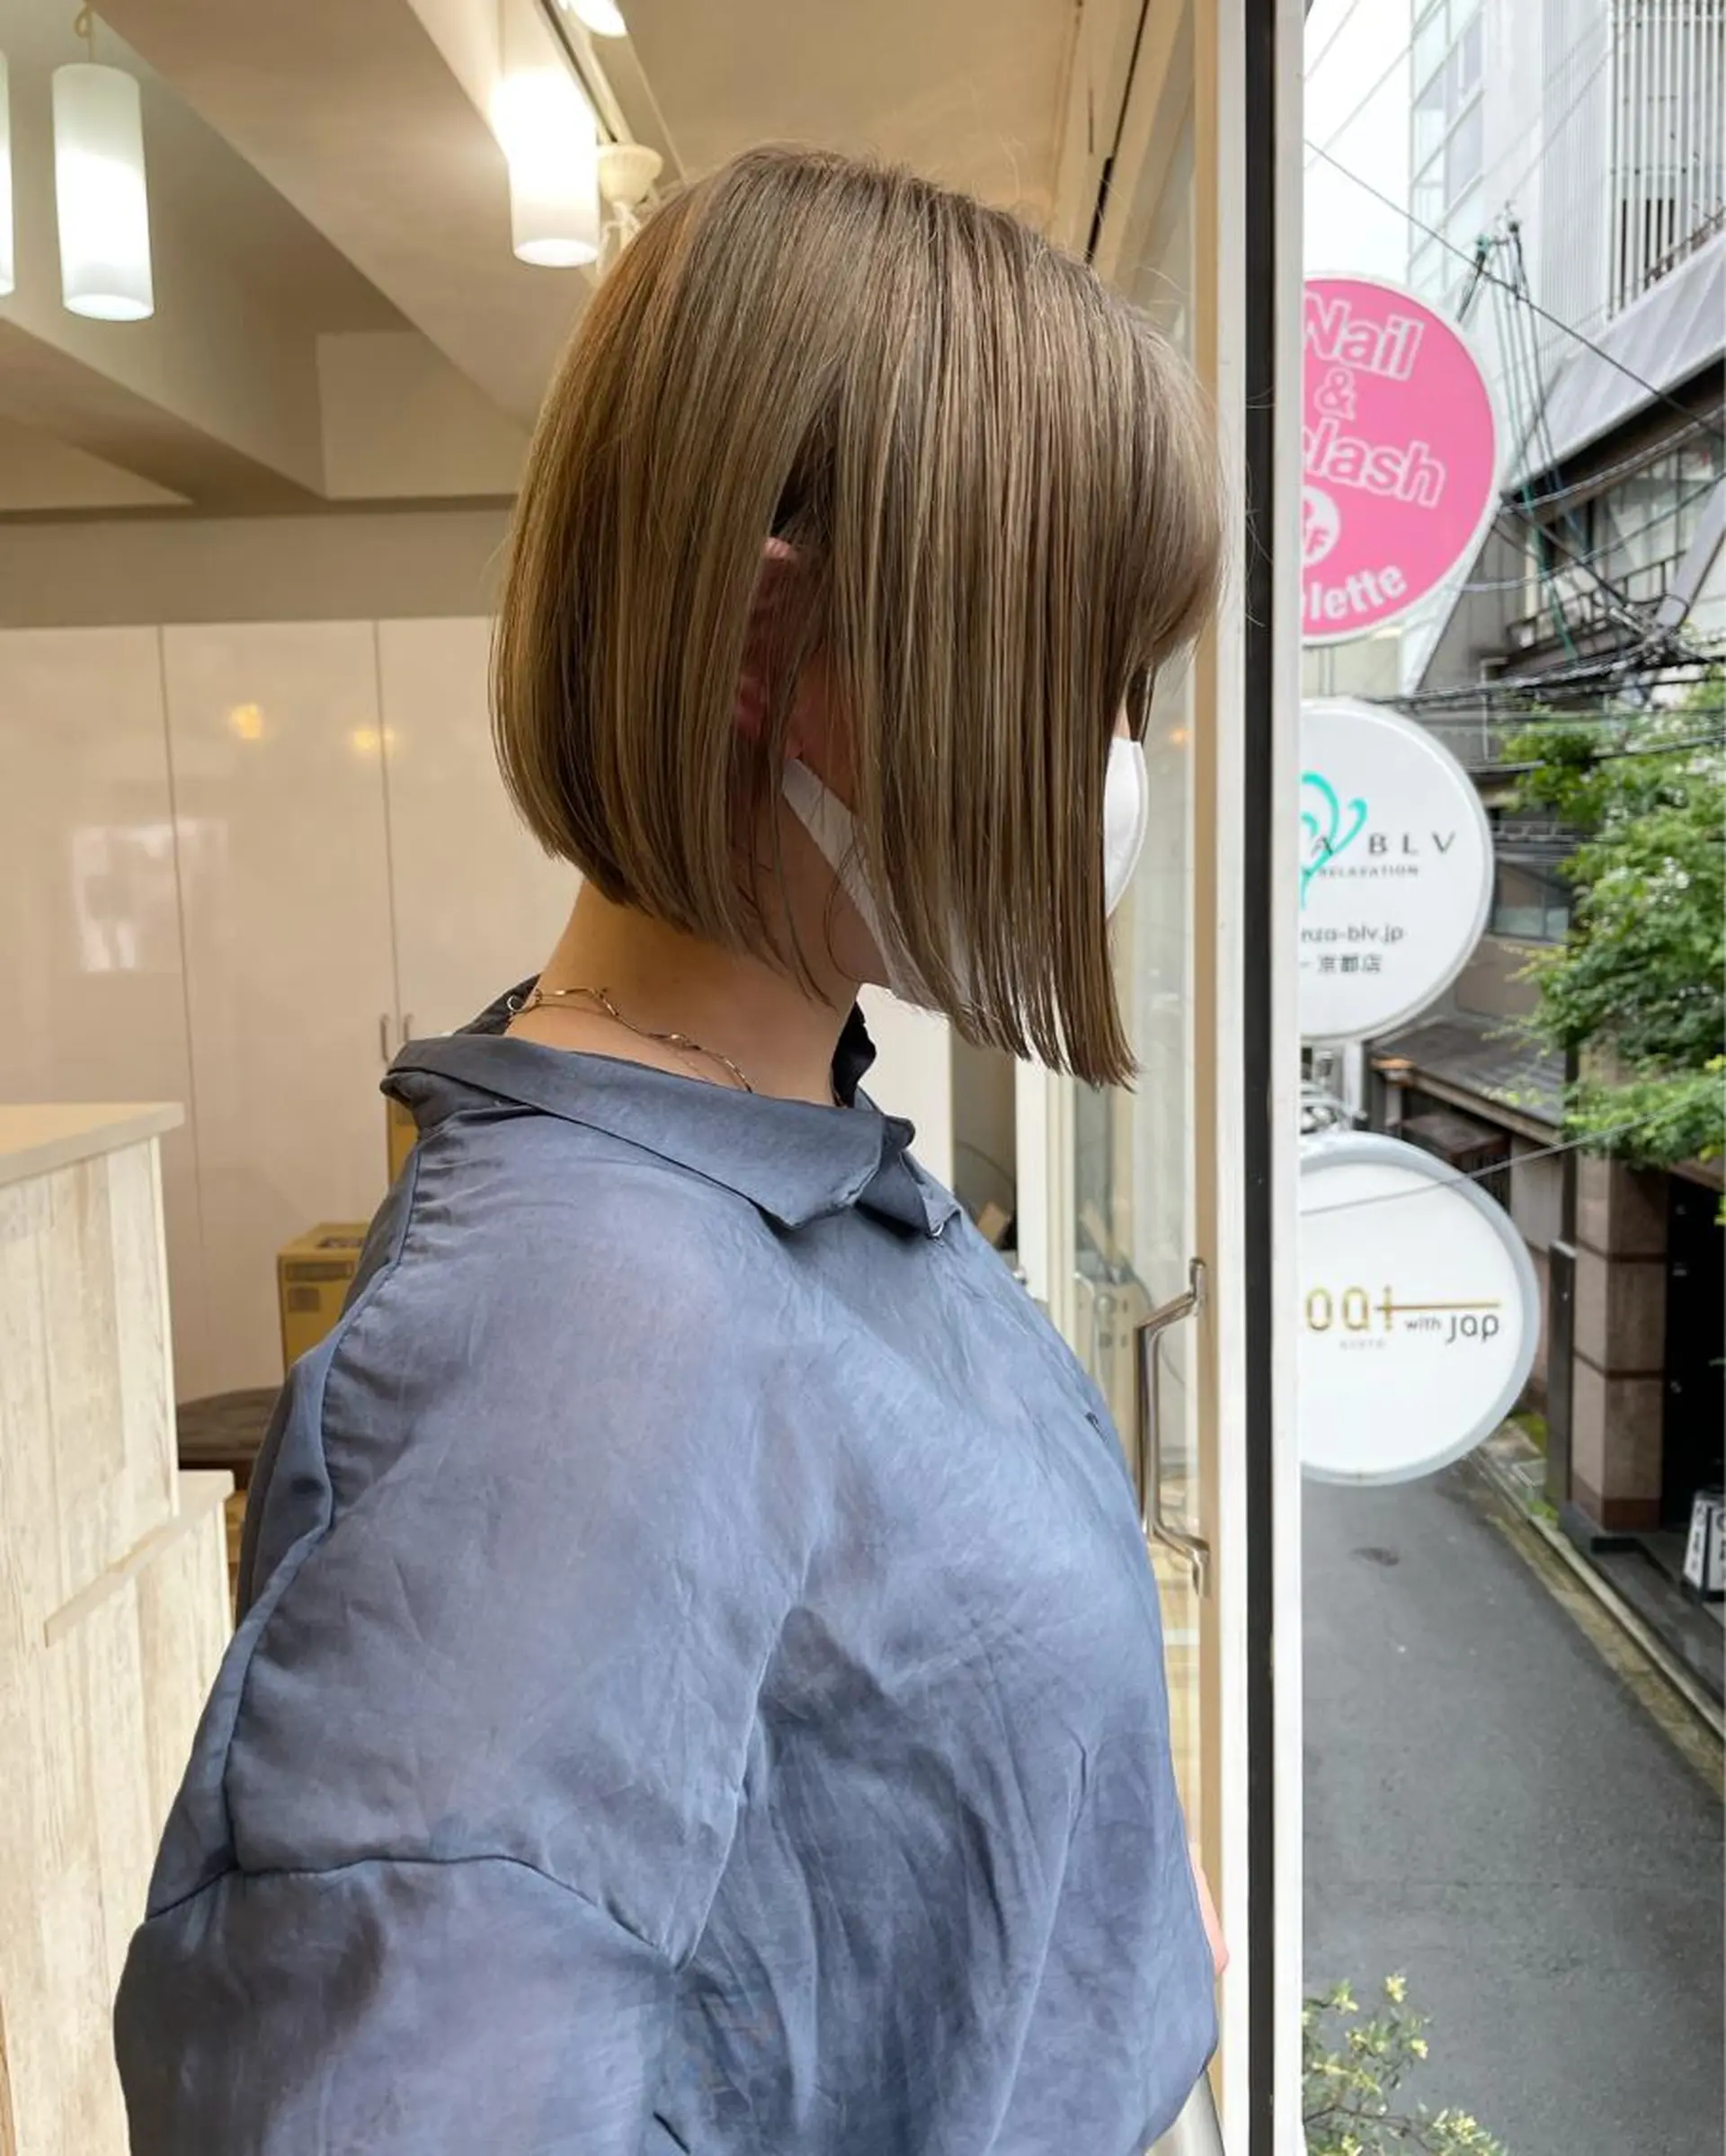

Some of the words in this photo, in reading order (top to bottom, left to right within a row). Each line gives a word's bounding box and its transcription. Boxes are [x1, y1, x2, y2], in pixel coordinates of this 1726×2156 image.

[1304, 292, 1424, 381] Nail
[1311, 366, 1356, 421] &
[1303, 565, 1408, 621] lette
